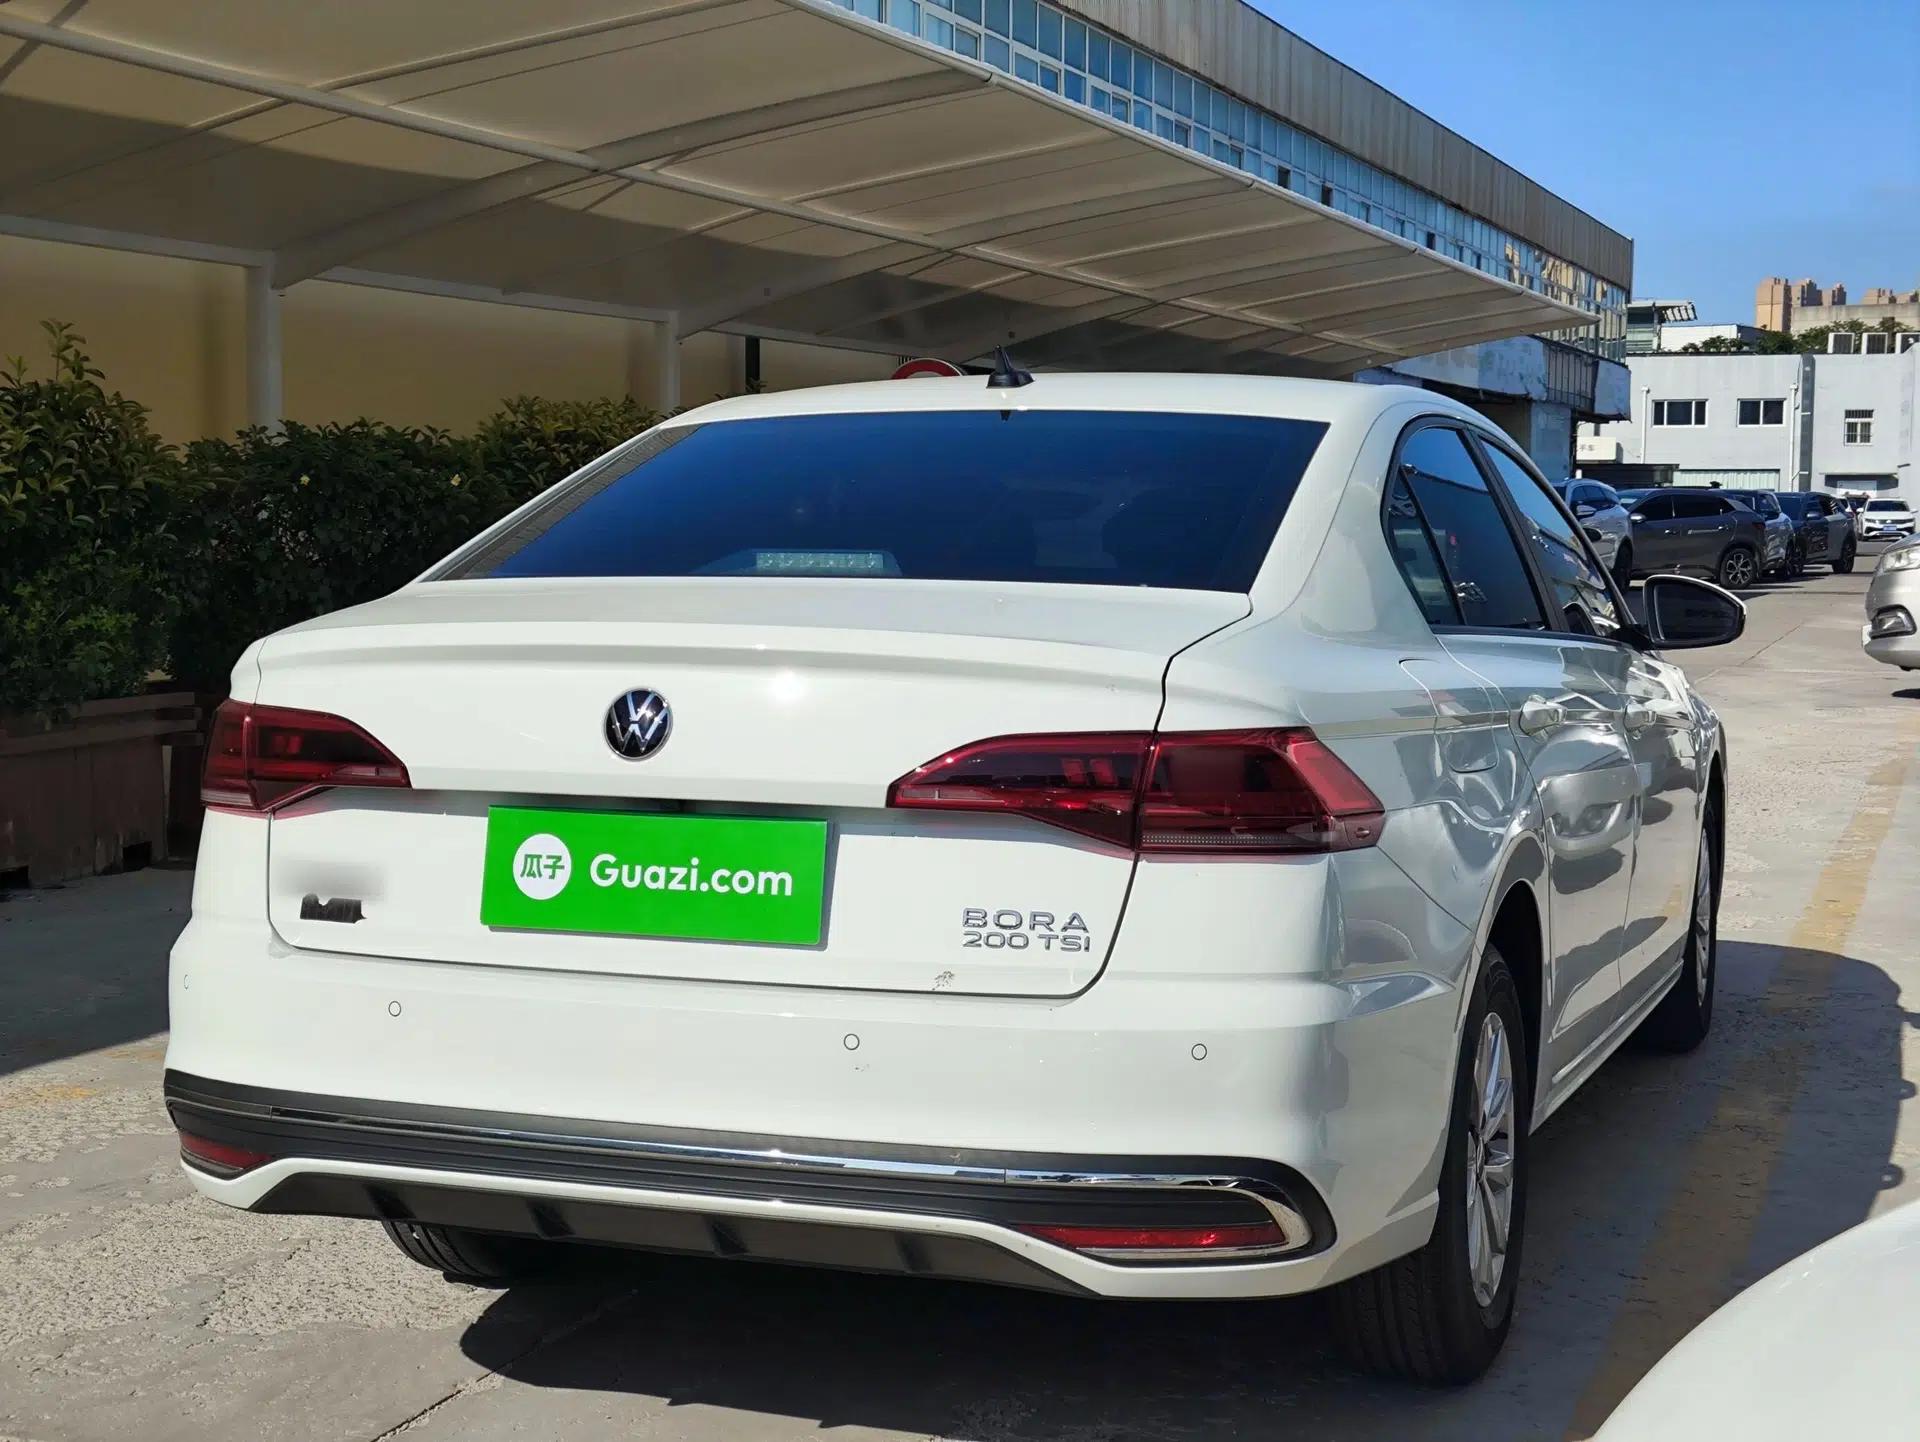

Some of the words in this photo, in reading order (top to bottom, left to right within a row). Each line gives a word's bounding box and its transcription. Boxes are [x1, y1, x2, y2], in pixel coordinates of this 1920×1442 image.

[520, 854, 565, 880] 瓜子
[590, 853, 793, 896] Guazi.com
[962, 907, 1089, 933] BORA
[962, 931, 1029, 950] 200
[1037, 934, 1090, 952] TSI
